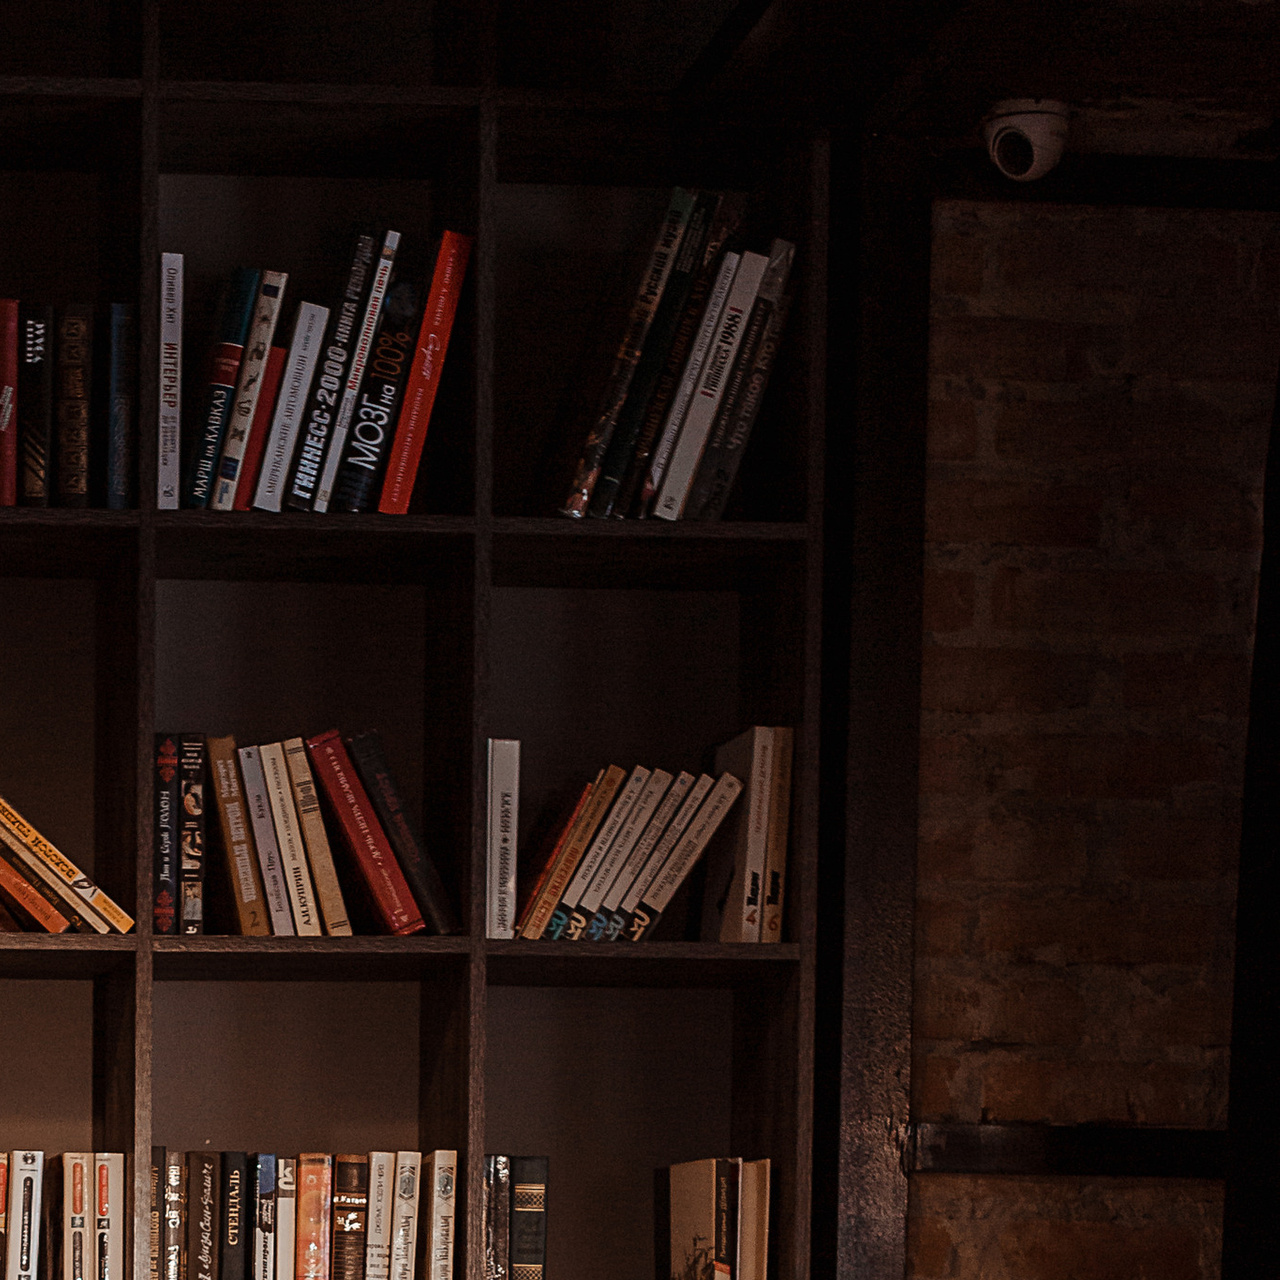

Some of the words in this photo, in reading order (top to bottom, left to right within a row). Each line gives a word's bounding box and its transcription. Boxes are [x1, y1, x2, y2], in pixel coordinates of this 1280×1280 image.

[162, 342, 177, 407] ИНТЕРЬЕР
[347, 295, 384, 391] Микроволновая
[371, 265, 389, 293] печь
[193, 460, 212, 498] МАРШ
[205, 390, 227, 442] КАВКАЗ
[347, 393, 390, 470] МОЗГ
[370, 332, 411, 381] 100%
[227, 1170, 240, 1245] СТЕНДАЛЬ
